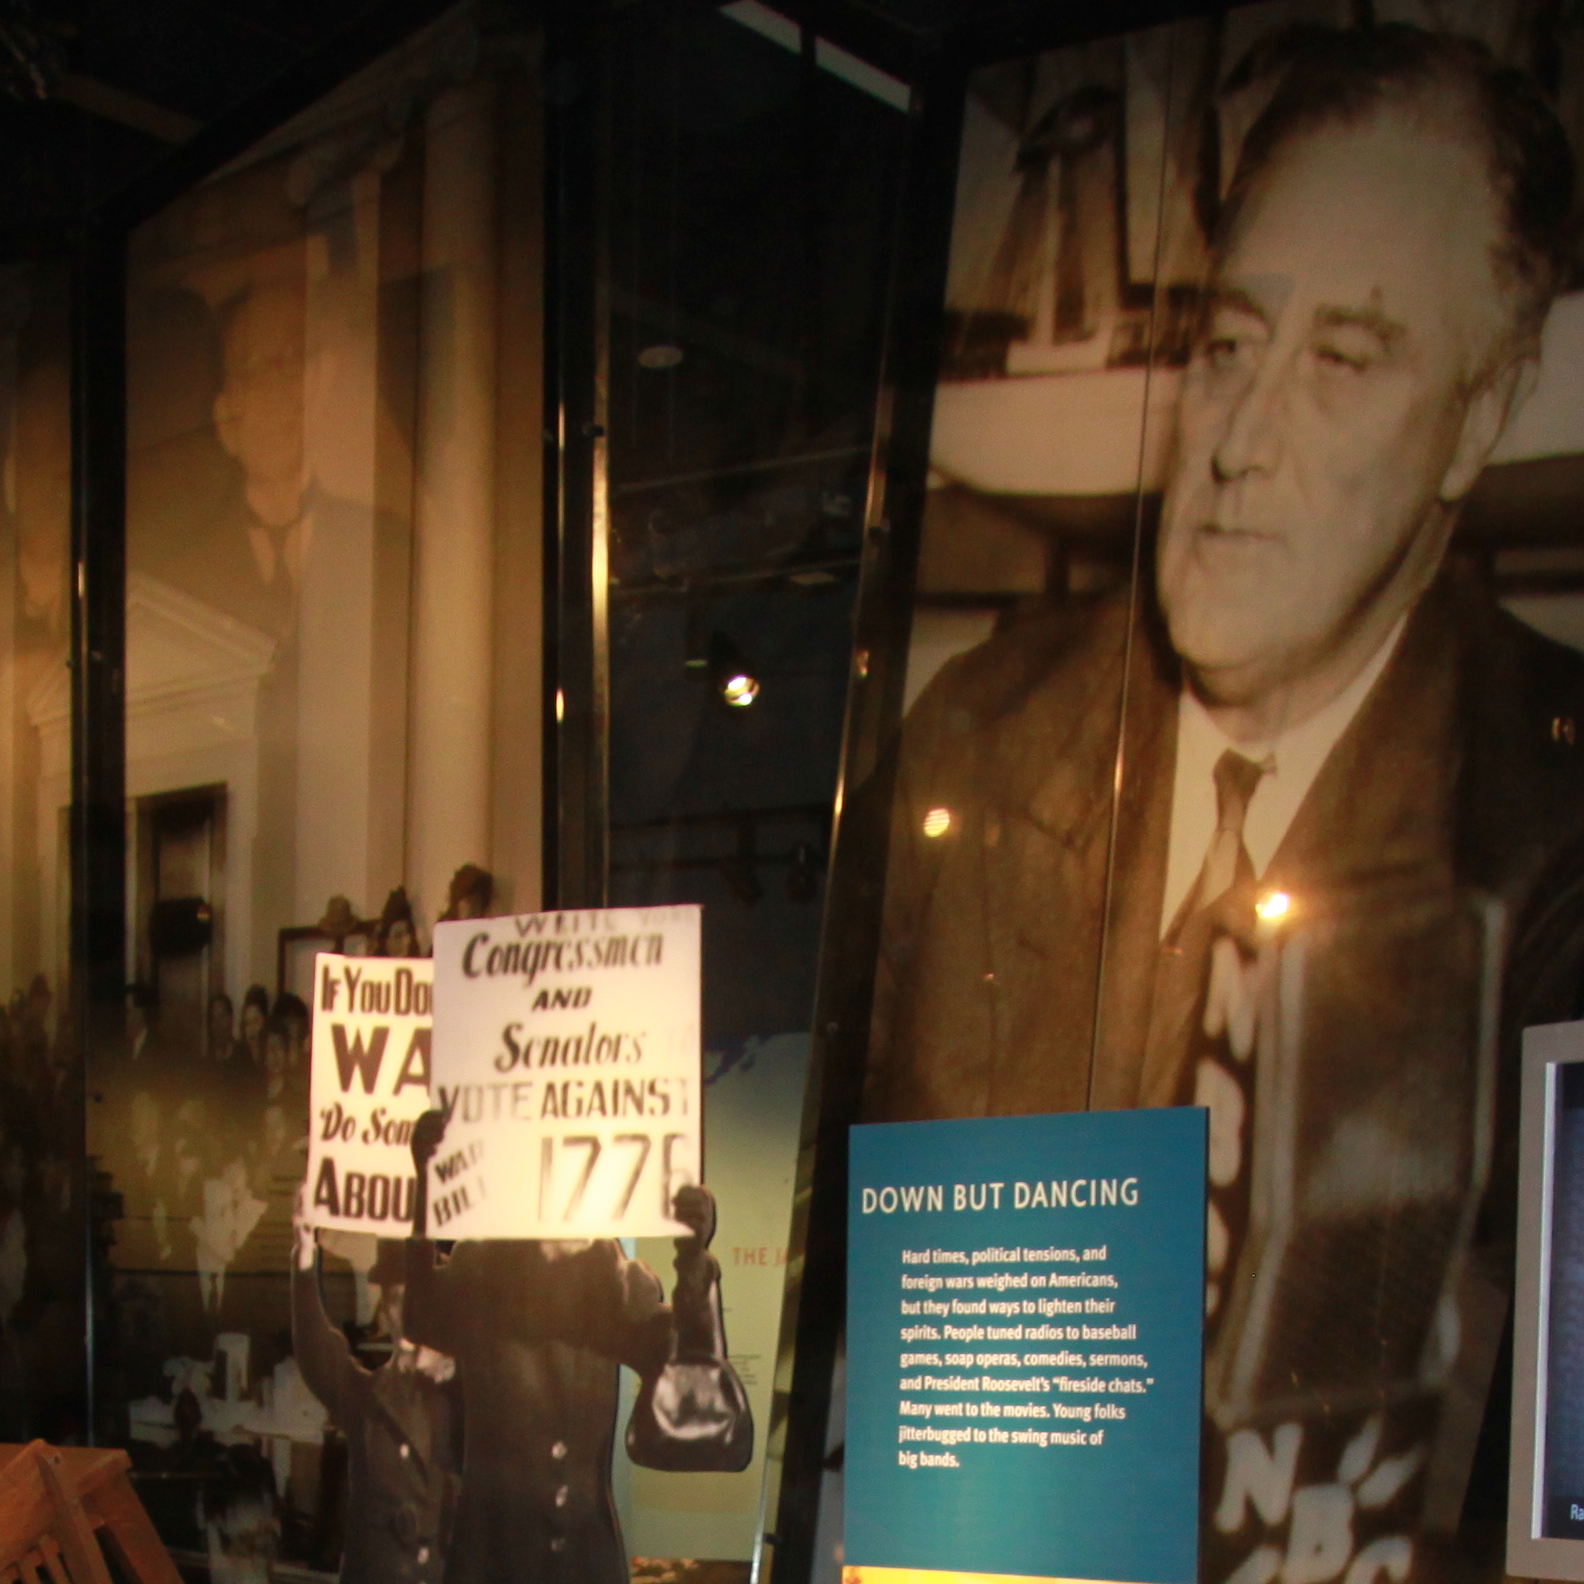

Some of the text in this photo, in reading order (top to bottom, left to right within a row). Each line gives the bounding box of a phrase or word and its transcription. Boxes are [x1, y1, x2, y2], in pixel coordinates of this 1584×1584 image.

[532, 987, 593, 1011] AND
[540, 1077, 689, 1119] AGAINST
[862, 1177, 1138, 1214] DOWN BUT DANCING
[733, 1247, 767, 1267] THE
[902, 1244, 1107, 1266] Hard times, political tensions, and
[901, 1271, 1119, 1293] foreign wars weighed on Americans,
[901, 1297, 1116, 1318] but they found ways to lighten their
[900, 1324, 1137, 1343] spirits. People tuned radios to baseball
[900, 1350, 1148, 1369] games, soap operas, comedies, sermons,
[899, 1375, 923, 1391] and
[924, 1375, 980, 1391] President
[899, 1400, 1126, 1423] Many went to the movies. Young folks
[898, 1425, 1104, 1448] jitterbugged to the swing music of
[898, 1450, 960, 1469] big bands.
